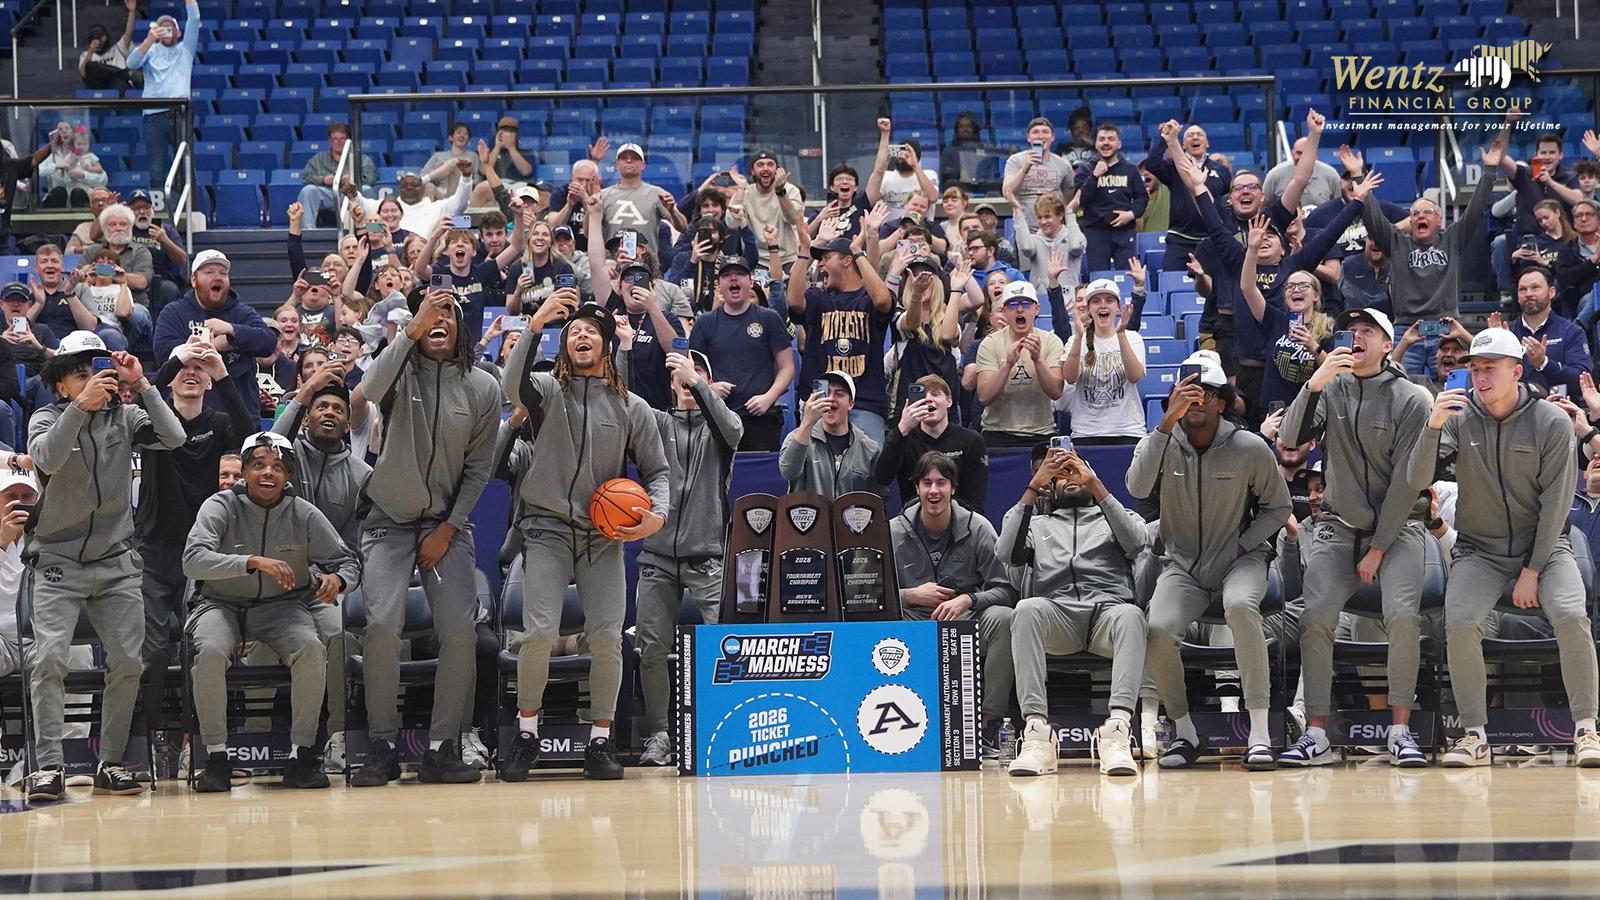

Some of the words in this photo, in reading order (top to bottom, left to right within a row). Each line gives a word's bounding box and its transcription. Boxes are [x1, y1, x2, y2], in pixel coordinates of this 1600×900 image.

[1097, 176, 1128, 188] AKRON
[1466, 164, 1481, 185] D
[150, 190, 165, 212] B
[608, 200, 648, 225] A
[1408, 247, 1448, 268] AKRON
[1011, 365, 1033, 380] A
[741, 638, 800, 656] MARCH
[748, 655, 829, 674] MADNESS
[951, 680, 959, 688] 15
[748, 708, 788, 729] 2026
[868, 702, 920, 736] A
[751, 724, 790, 743] TICKET
[1058, 728, 1097, 742] FSM
[1350, 725, 1394, 738] FSM
[540, 738, 570, 752] SM
[684, 713, 692, 770] #MARCHMADNESS
[953, 736, 961, 766] SECTION
[227, 747, 269, 761] FSM
[729, 735, 819, 771] PUNCHED
